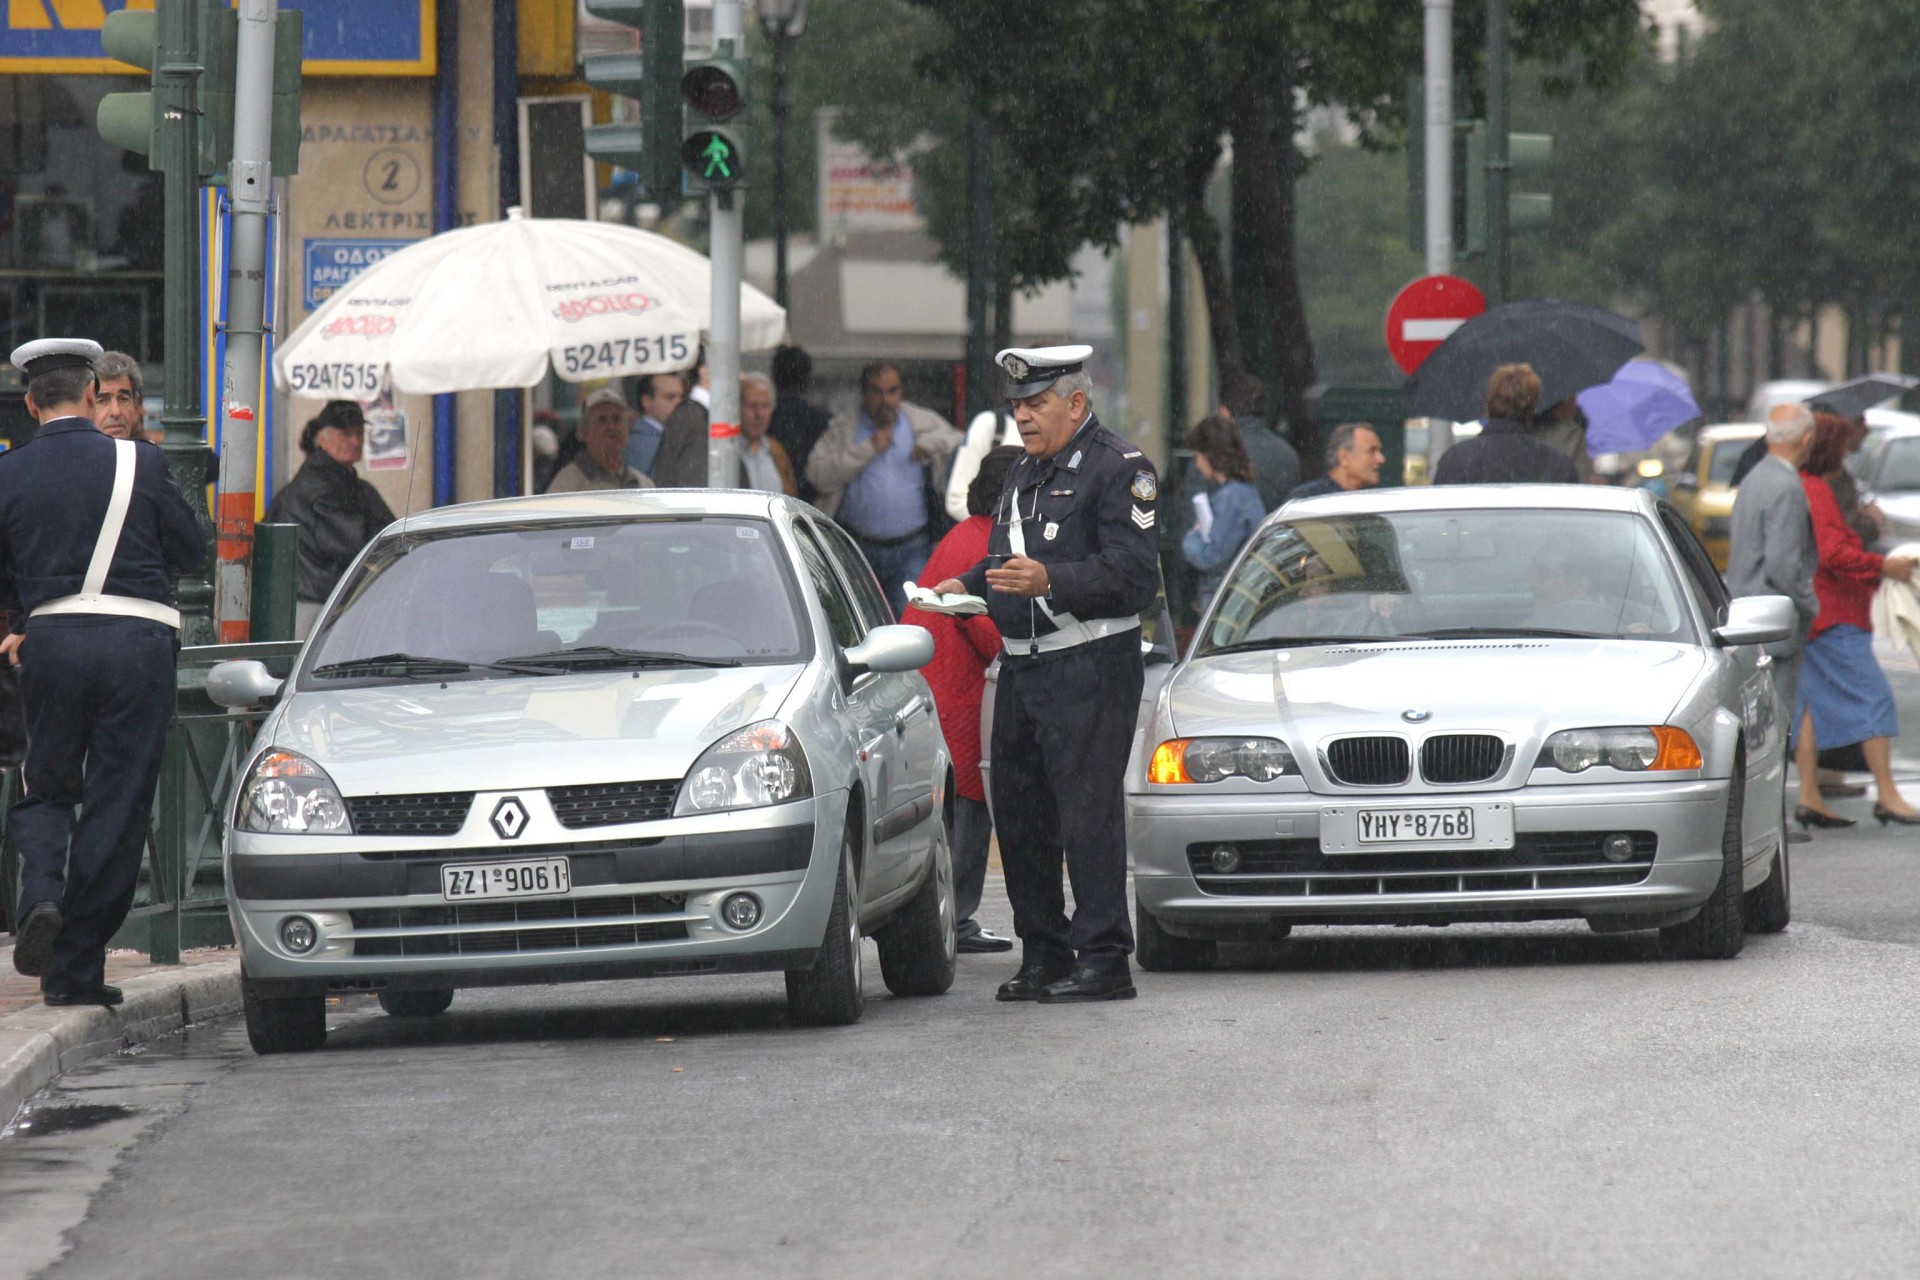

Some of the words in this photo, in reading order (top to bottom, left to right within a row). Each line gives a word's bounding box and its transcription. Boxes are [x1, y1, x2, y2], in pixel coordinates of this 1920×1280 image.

[381, 160, 400, 190] 2
[559, 292, 649, 320] APOLLO
[564, 335, 687, 373] 5247515
[291, 364, 377, 391] 5247515
